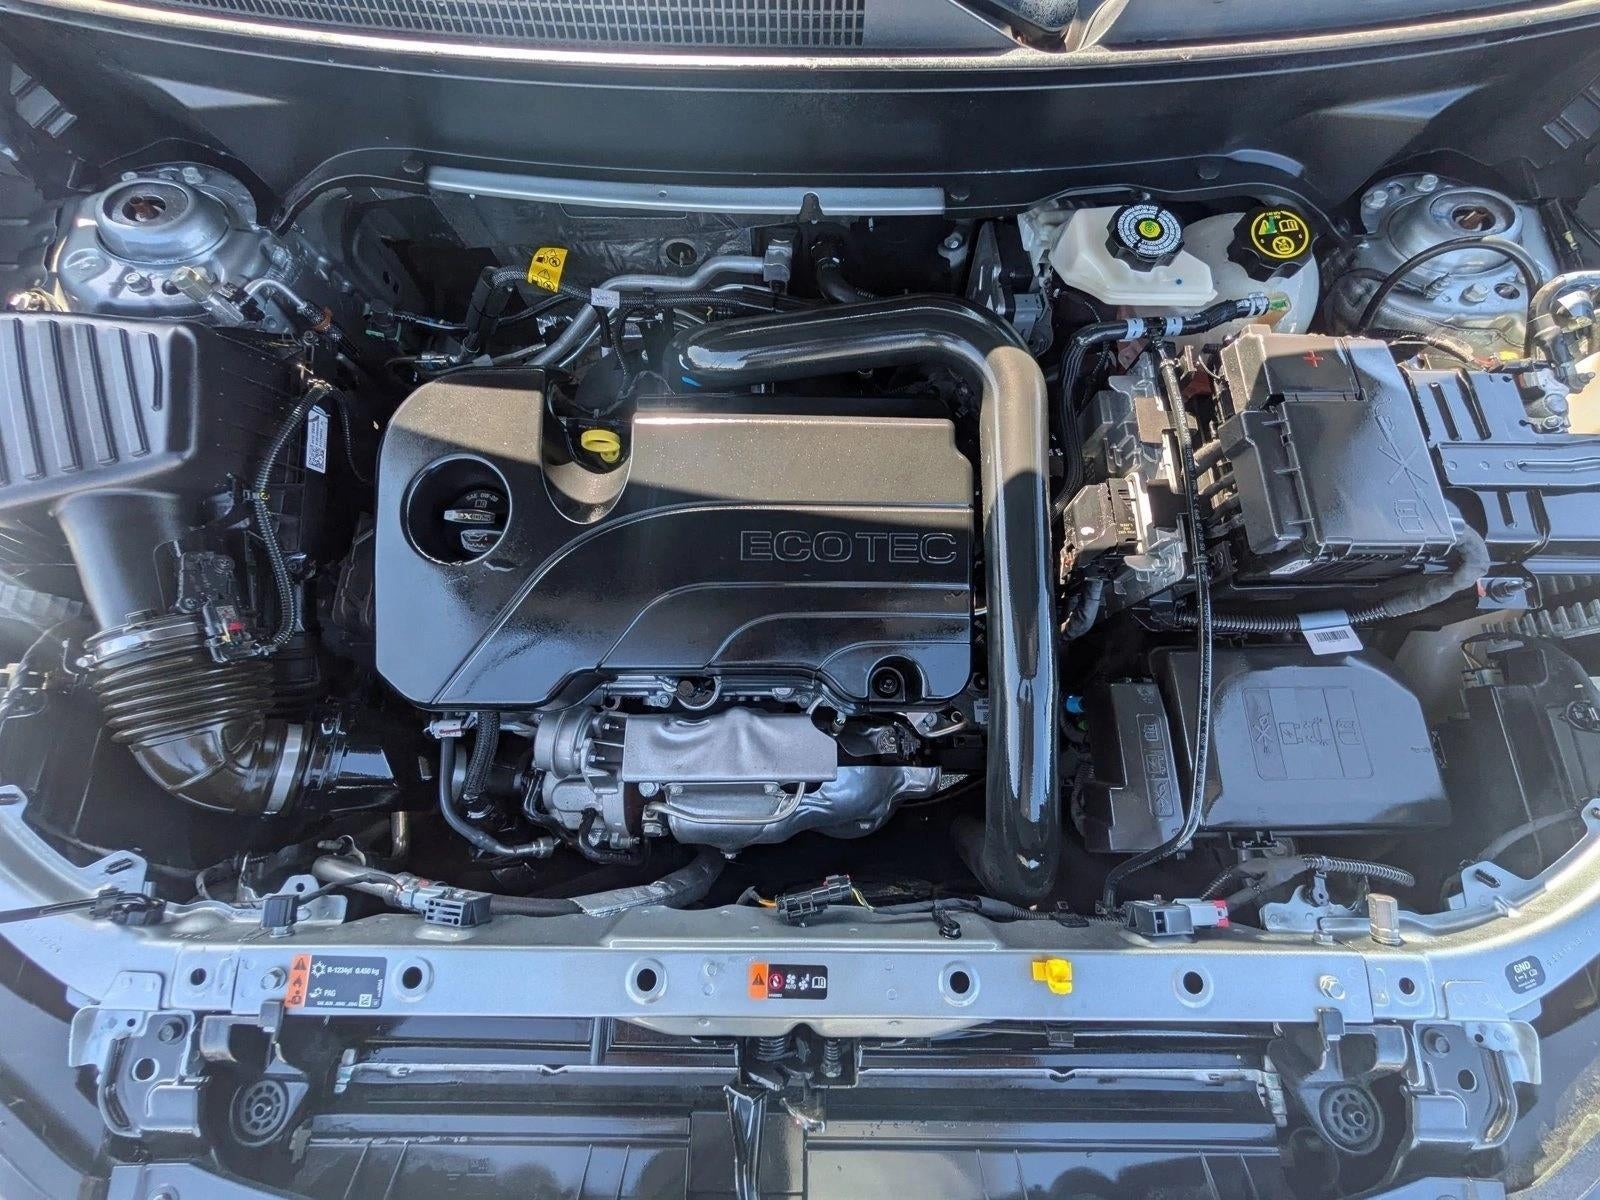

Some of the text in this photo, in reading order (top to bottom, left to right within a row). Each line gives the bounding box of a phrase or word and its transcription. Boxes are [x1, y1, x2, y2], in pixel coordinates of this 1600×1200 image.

[740, 530, 957, 564] ECOTEC
[1513, 961, 1531, 974] GND
[324, 989, 336, 997] PAG
